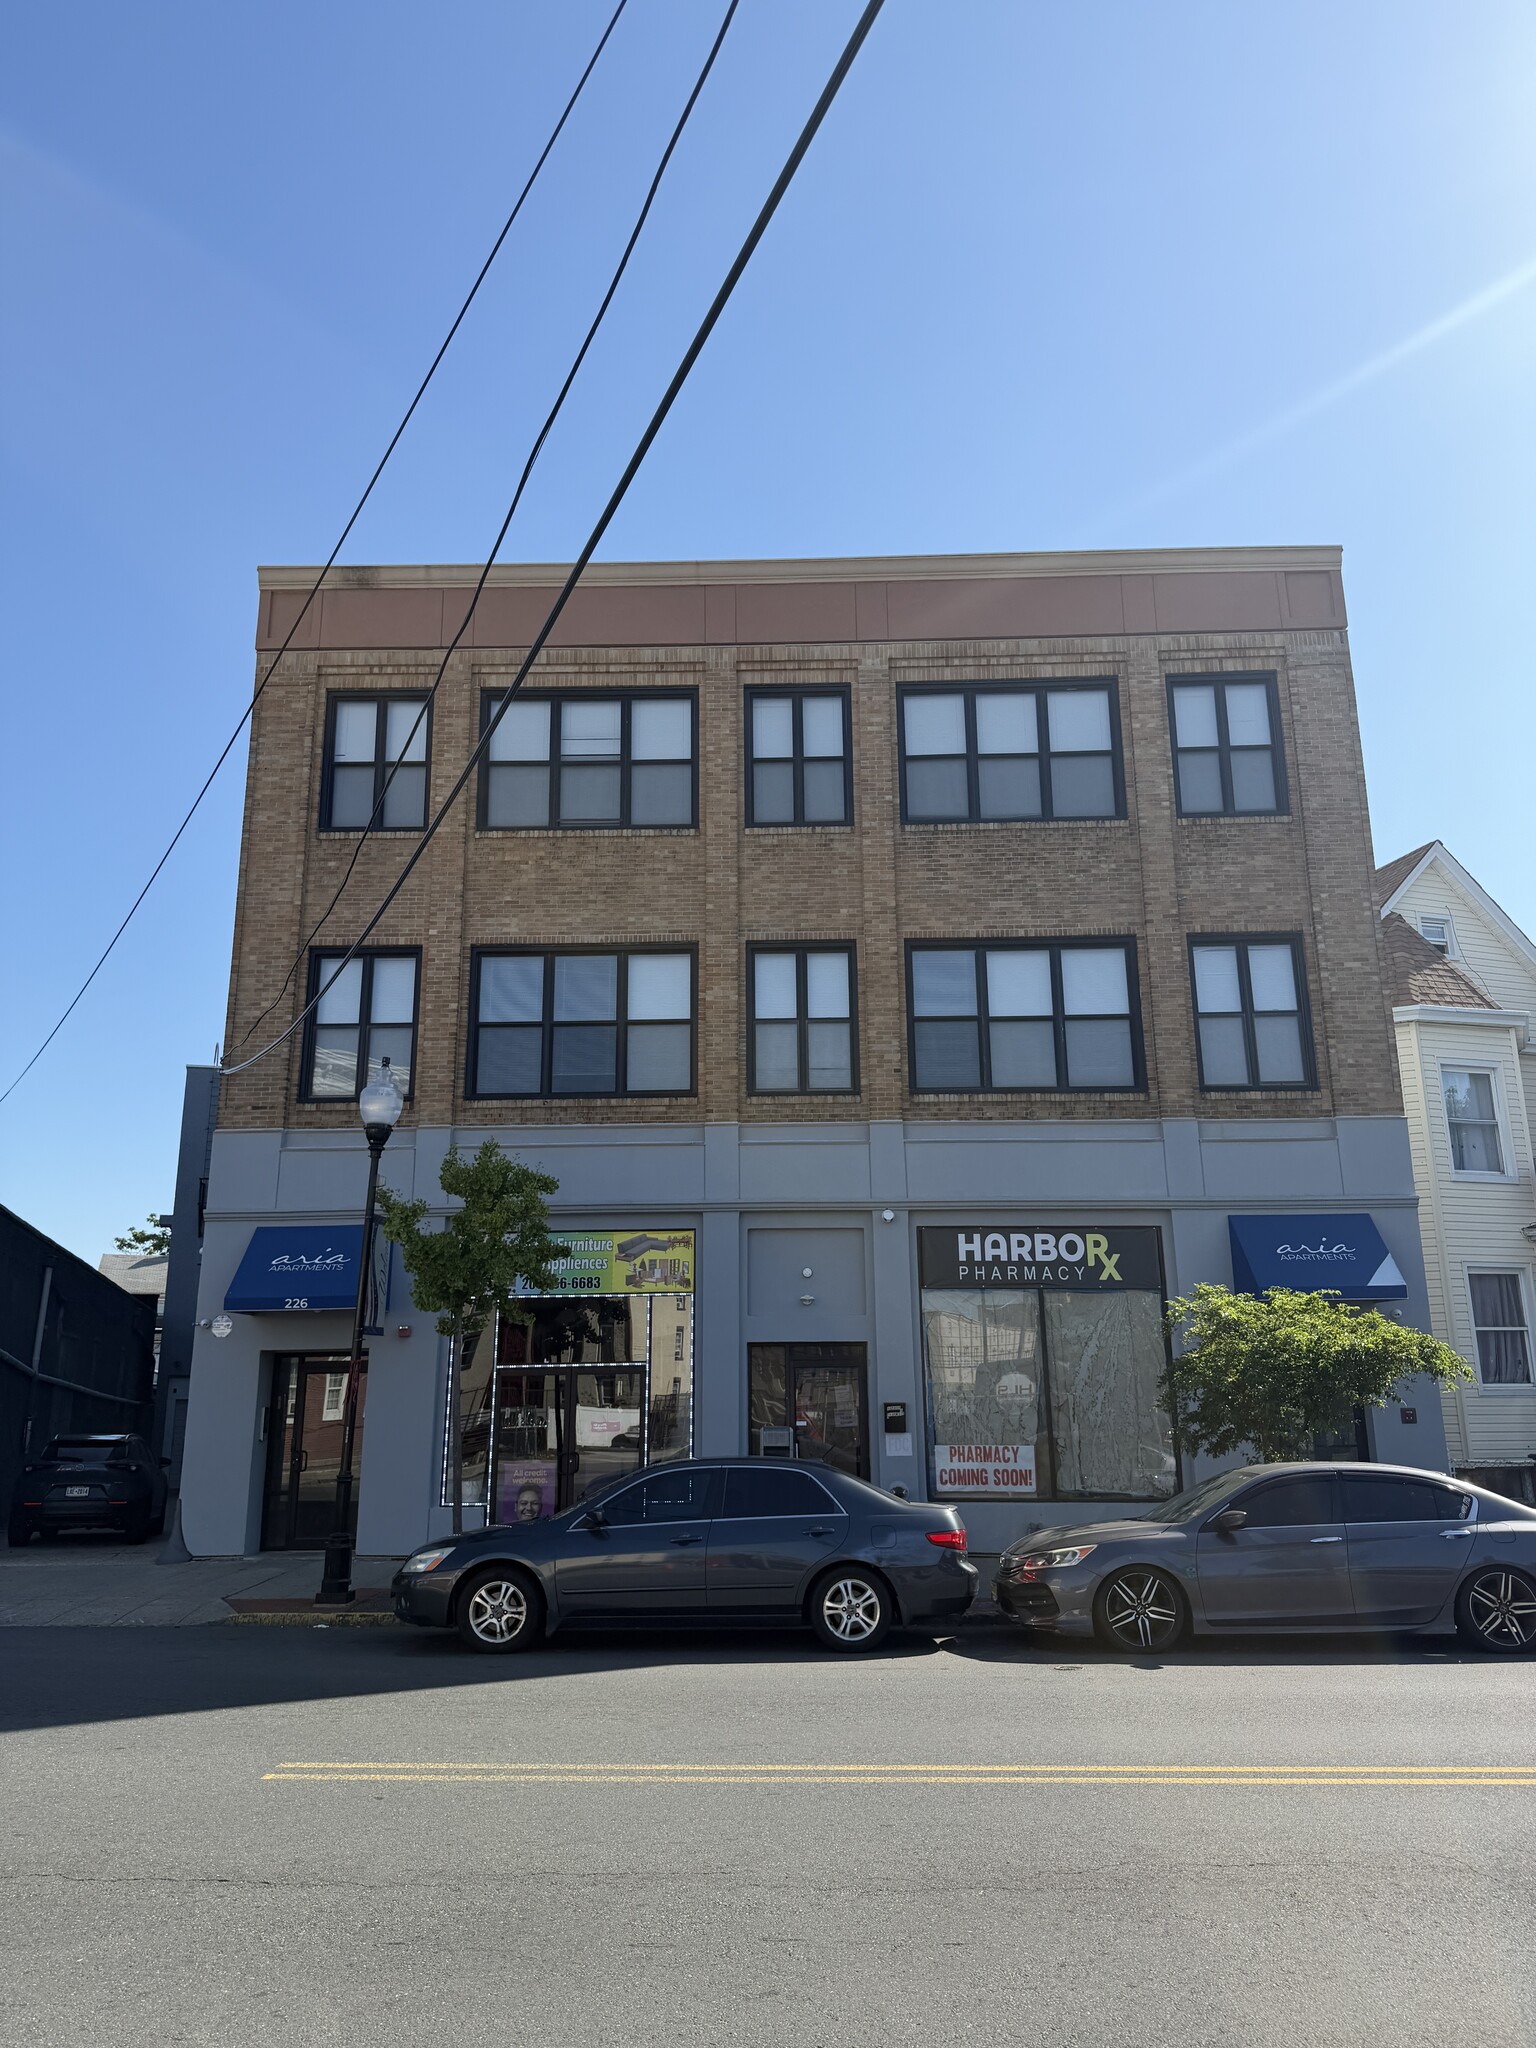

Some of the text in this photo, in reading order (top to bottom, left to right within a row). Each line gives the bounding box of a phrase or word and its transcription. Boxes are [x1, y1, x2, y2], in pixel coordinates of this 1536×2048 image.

[1276, 1237, 1356, 1253] aria
[271, 1247, 351, 1264] aria
[268, 1263, 344, 1271] APARTMENTS
[958, 1265, 1085, 1281] PHARMACY
[284, 1298, 308, 1309] 226
[949, 1445, 1020, 1463] PHARMACY
[939, 1468, 1033, 1487] COMING SOON!
